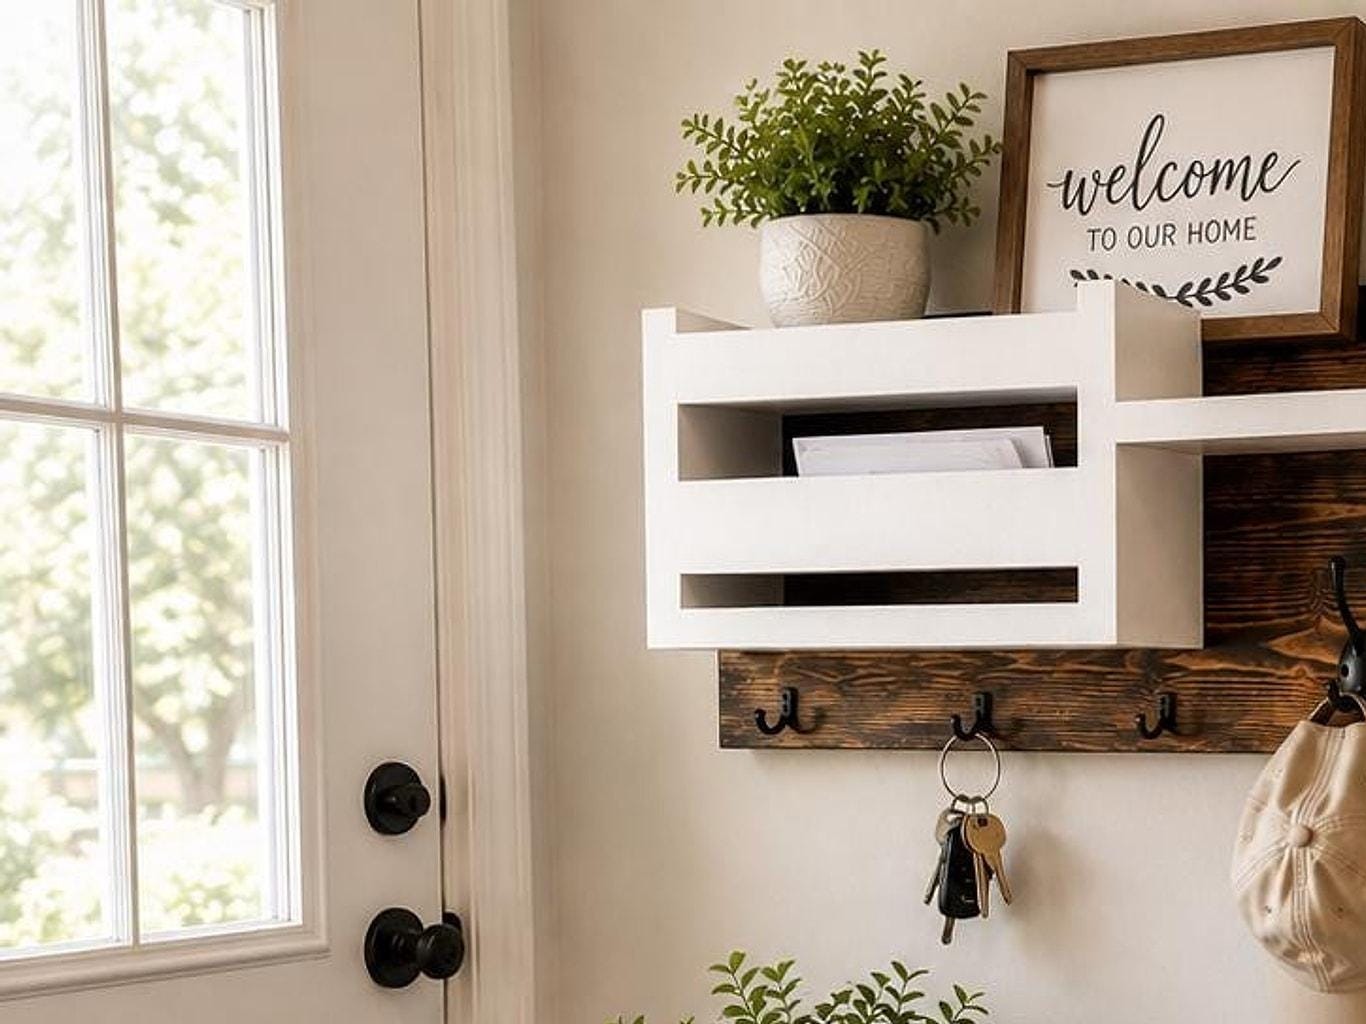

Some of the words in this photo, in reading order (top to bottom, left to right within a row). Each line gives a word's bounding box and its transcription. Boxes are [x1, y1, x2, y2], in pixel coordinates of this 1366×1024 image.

[1047, 113, 1301, 216] welcome
[1086, 226, 1116, 252] TO
[1127, 222, 1177, 250] OUR
[1187, 216, 1257, 246] HOME
